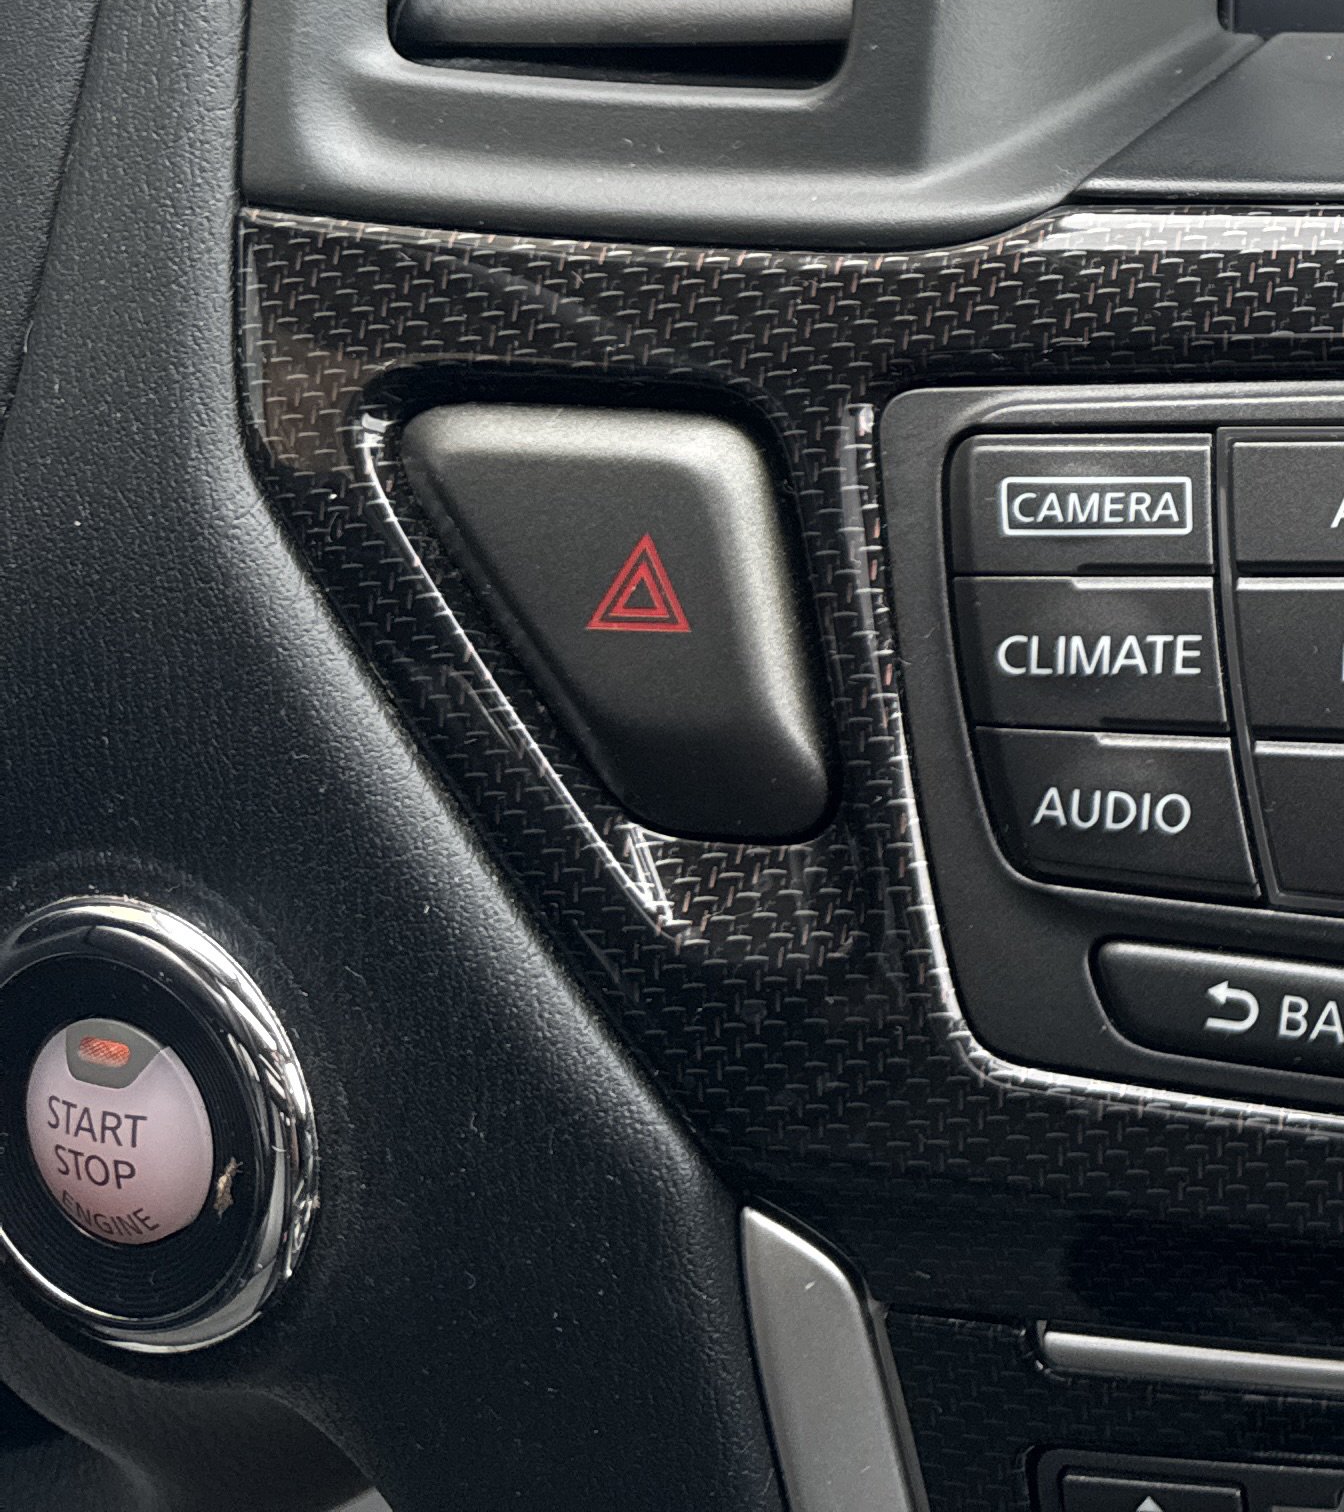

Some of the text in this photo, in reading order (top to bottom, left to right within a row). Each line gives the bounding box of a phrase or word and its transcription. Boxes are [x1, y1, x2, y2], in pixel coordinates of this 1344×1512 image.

[1012, 491, 1181, 524] CAMERA
[998, 634, 1203, 676] CLIMATE
[1033, 786, 1192, 834] AUDIO
[47, 1094, 148, 1149] START
[54, 1143, 136, 1190] STOP
[61, 1189, 161, 1237] ENGINE
